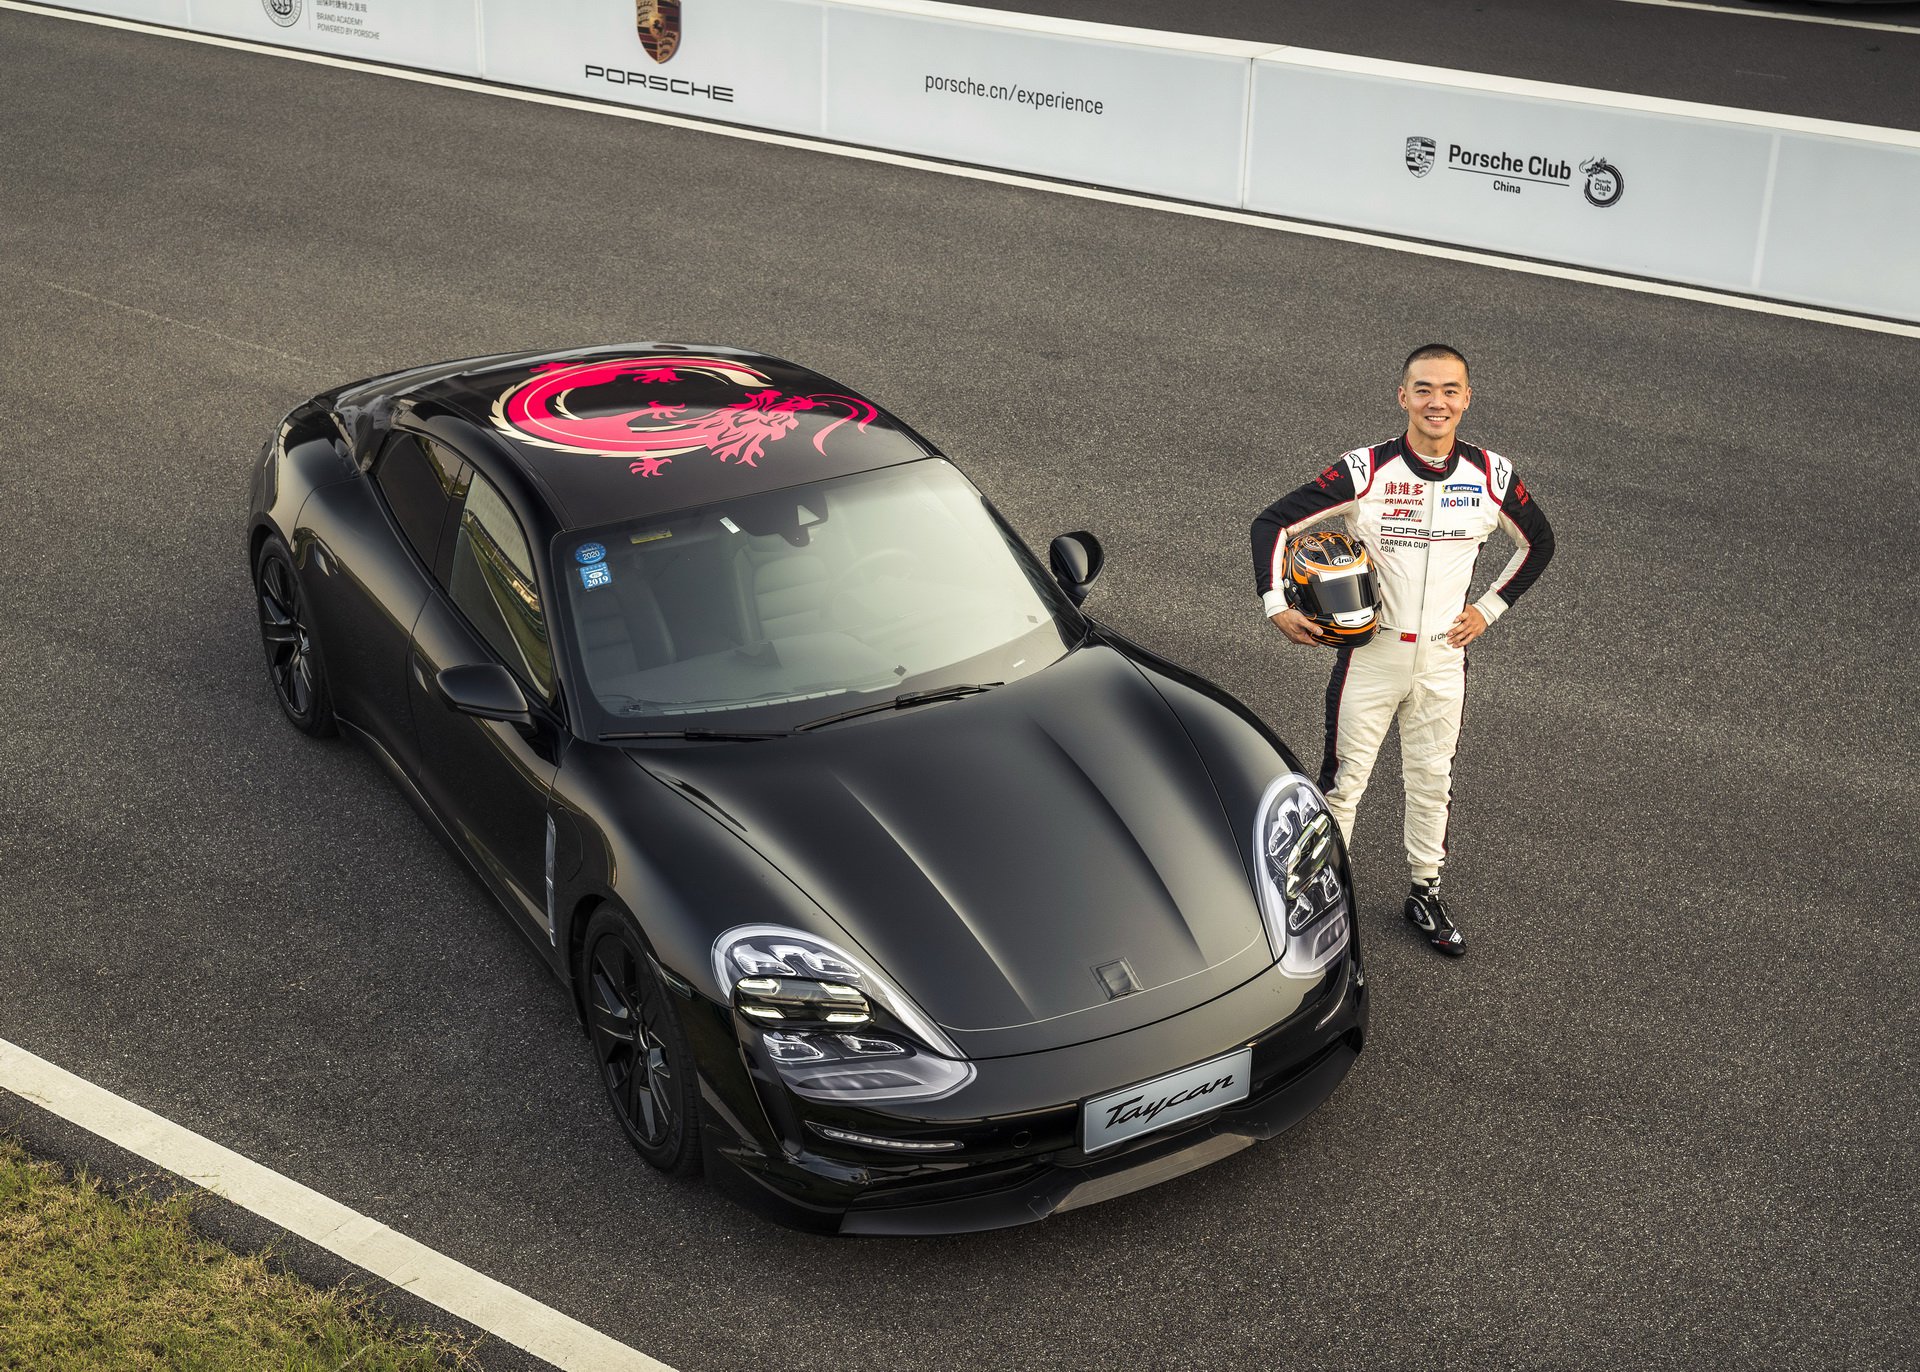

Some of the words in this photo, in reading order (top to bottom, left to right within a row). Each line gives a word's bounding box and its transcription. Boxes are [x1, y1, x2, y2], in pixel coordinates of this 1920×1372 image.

[316, 12, 336, 22] BRAND
[336, 16, 363, 26] ACADEMY
[317, 23, 345, 35] POWERED
[345, 27, 354, 36] BY
[354, 29, 380, 40] PORSCHE
[585, 64, 734, 103] PORSCHE
[925, 74, 1104, 115] porsche.cn/experience
[1448, 143, 1524, 173] Porsche
[1528, 155, 1572, 181] Club
[1493, 180, 1522, 194] China
[1594, 182, 1612, 193] Club
[1384, 481, 1424, 496] 康维多
[1384, 498, 1423, 506] PRIMAVITA
[1440, 496, 1469, 508] Mobil
[1380, 525, 1467, 538] PORSCHE
[1380, 538, 1413, 548] CARRERA
[1413, 541, 1429, 550] CUP
[1380, 545, 1396, 554] ASIA
[582, 550, 600, 560] 2020
[586, 575, 609, 587] 2019
[1104, 1074, 1235, 1130] Taycan
